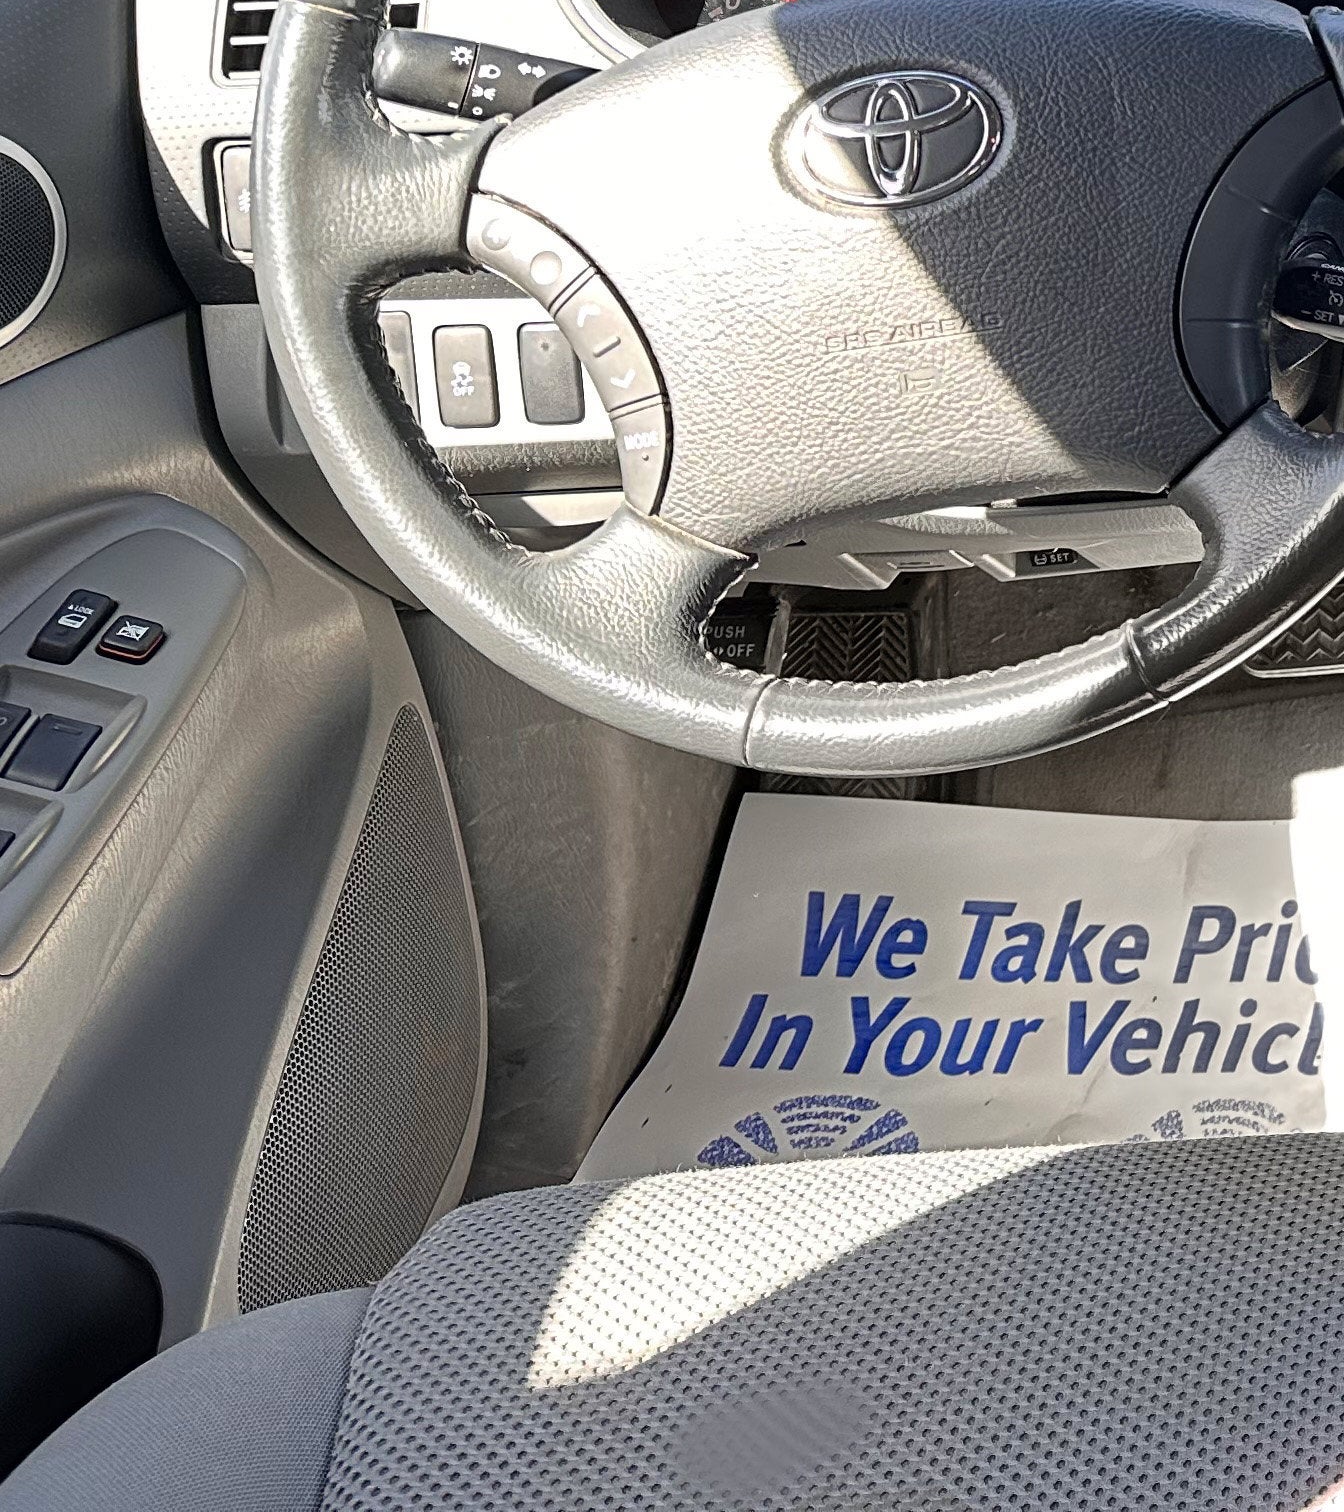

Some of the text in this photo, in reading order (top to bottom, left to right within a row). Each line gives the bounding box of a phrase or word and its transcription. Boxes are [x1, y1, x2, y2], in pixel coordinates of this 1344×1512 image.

[1324, 273, 1344, 287] RES
[1313, 309, 1335, 323] SET
[623, 430, 661, 451] MODE
[1049, 551, 1070, 564] SET
[74, 603, 95, 616] LOCK
[726, 643, 756, 658] OFF
[800, 890, 928, 981] We
[958, 898, 1152, 985] Take
[719, 993, 813, 1071] In
[843, 995, 1043, 1077] Your
